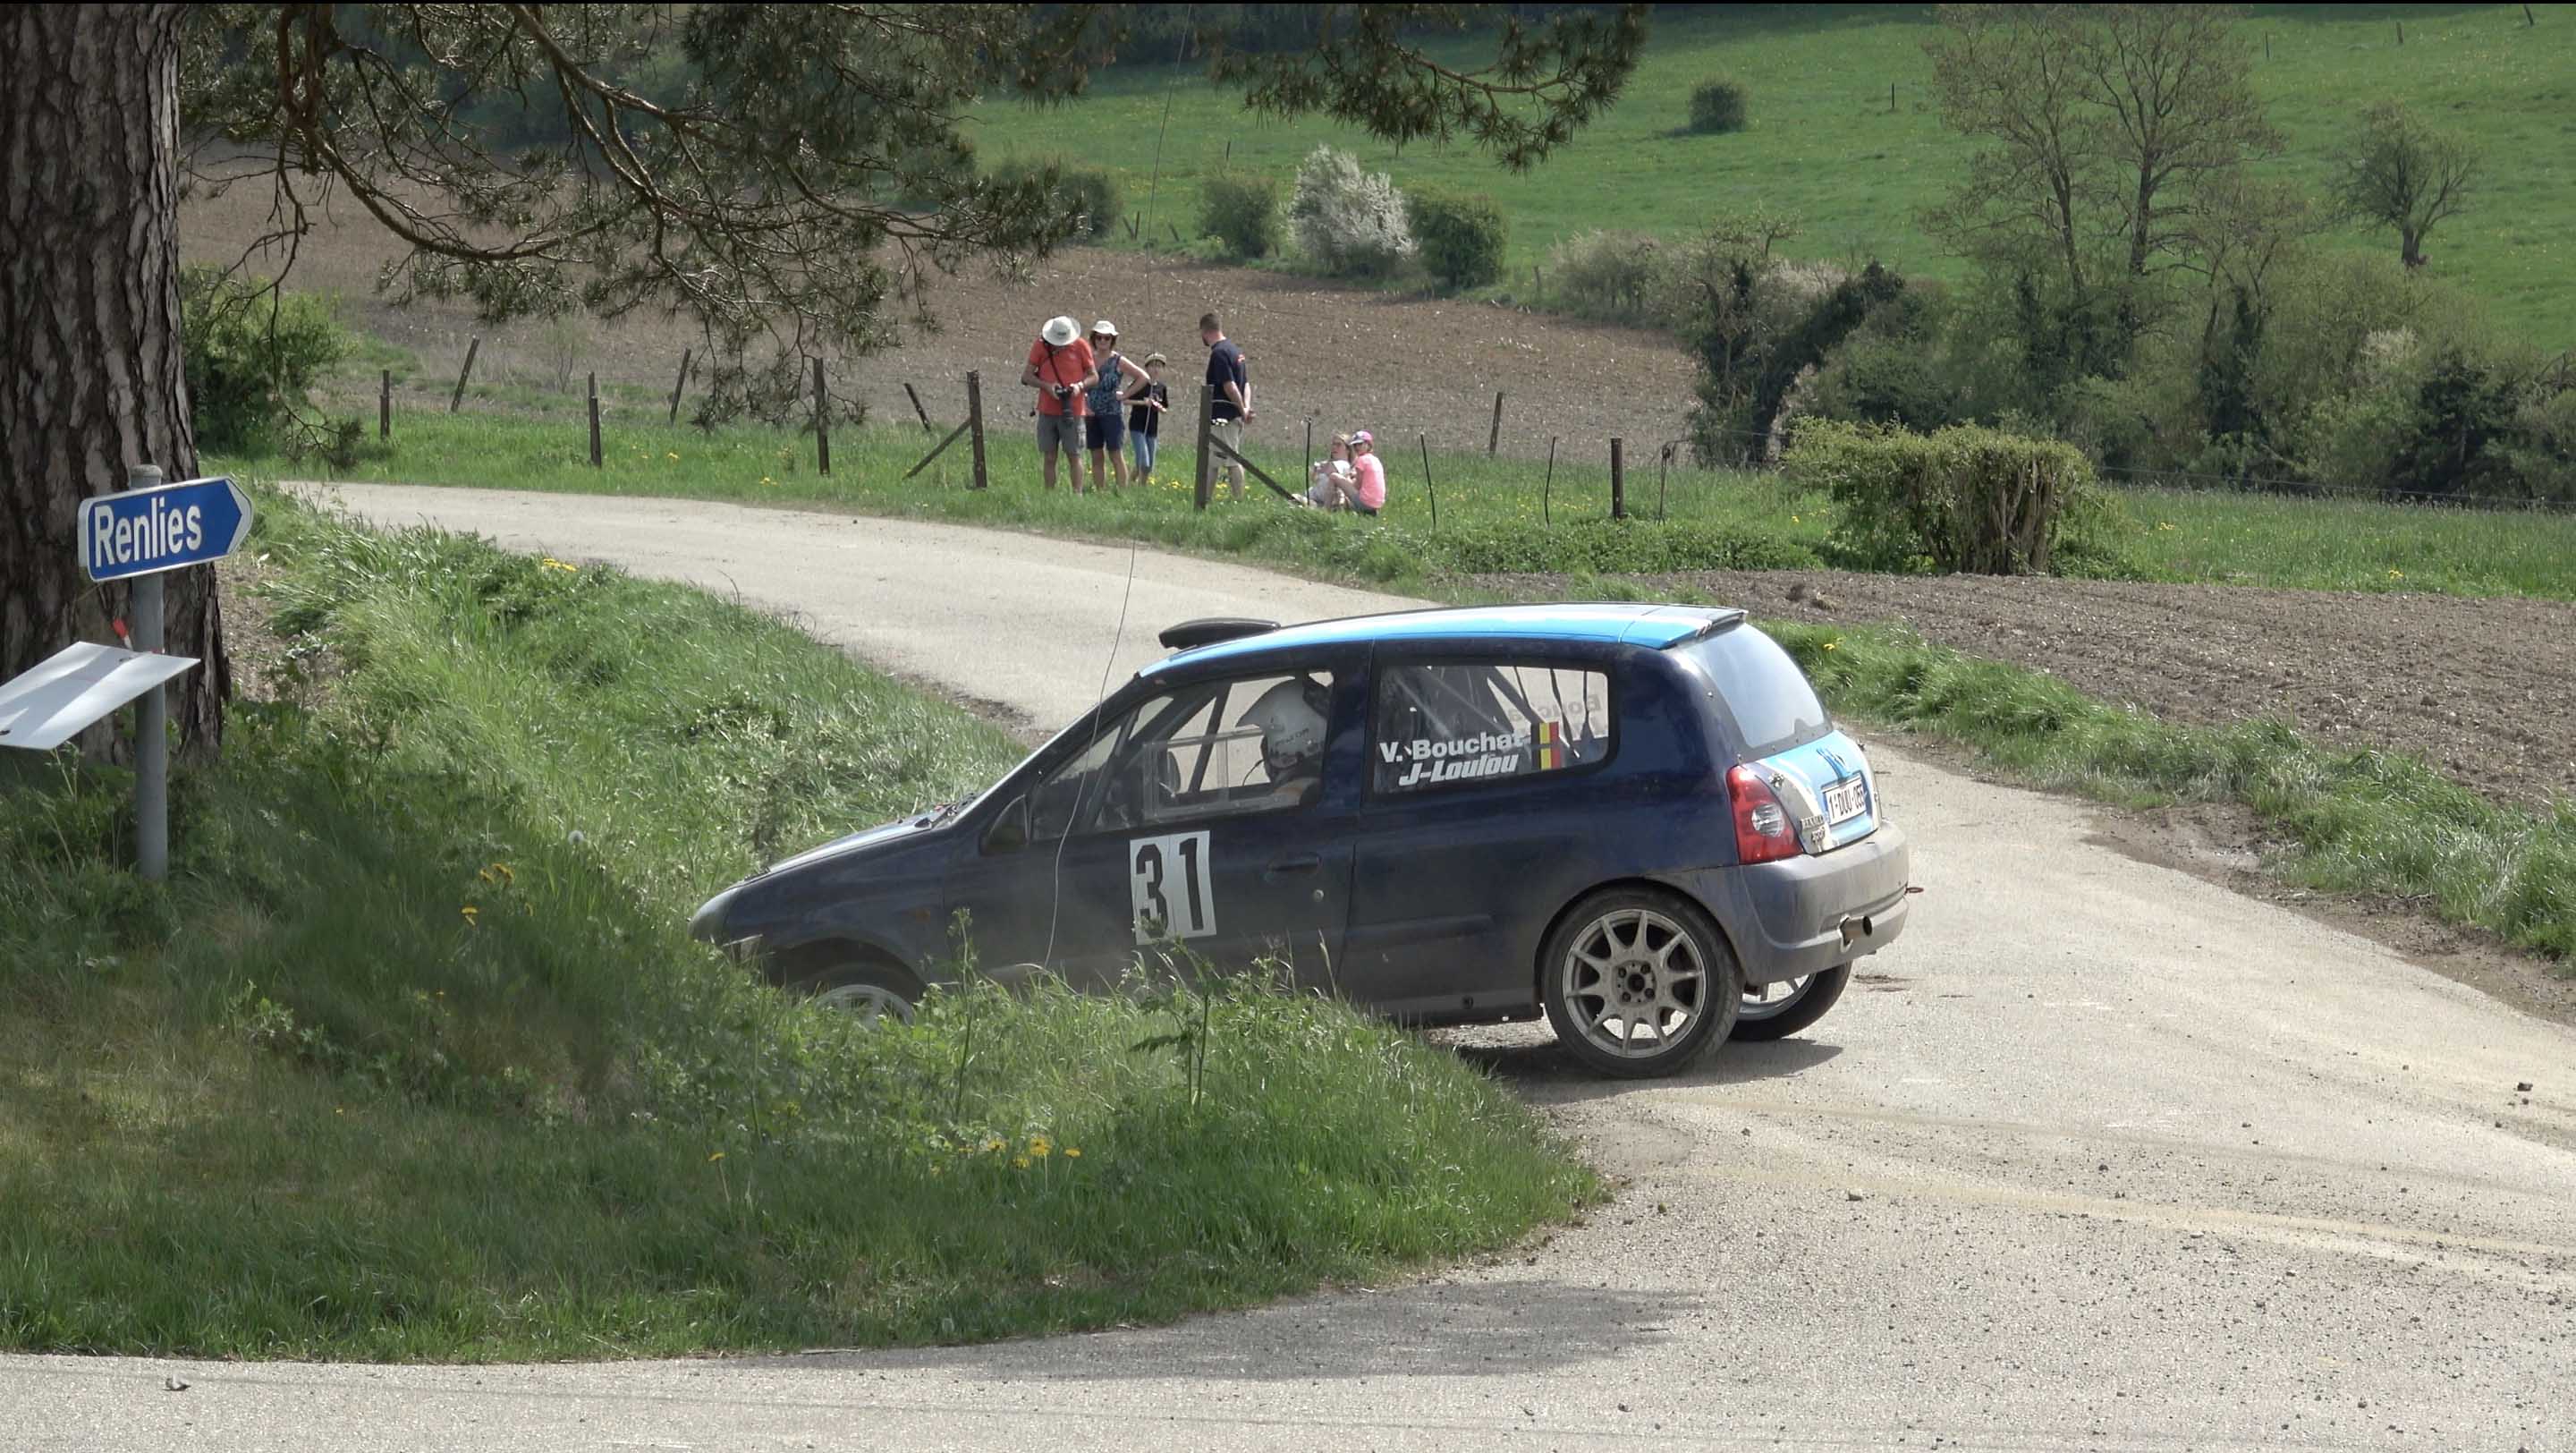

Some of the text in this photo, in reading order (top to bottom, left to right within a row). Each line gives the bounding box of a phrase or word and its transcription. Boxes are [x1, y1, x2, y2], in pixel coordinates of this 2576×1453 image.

[94, 497, 202, 568] Renlies
[1379, 731, 1525, 763] V. Bouchat
[1399, 753, 1519, 786] J-Loulou
[1135, 837, 1205, 939] 31
